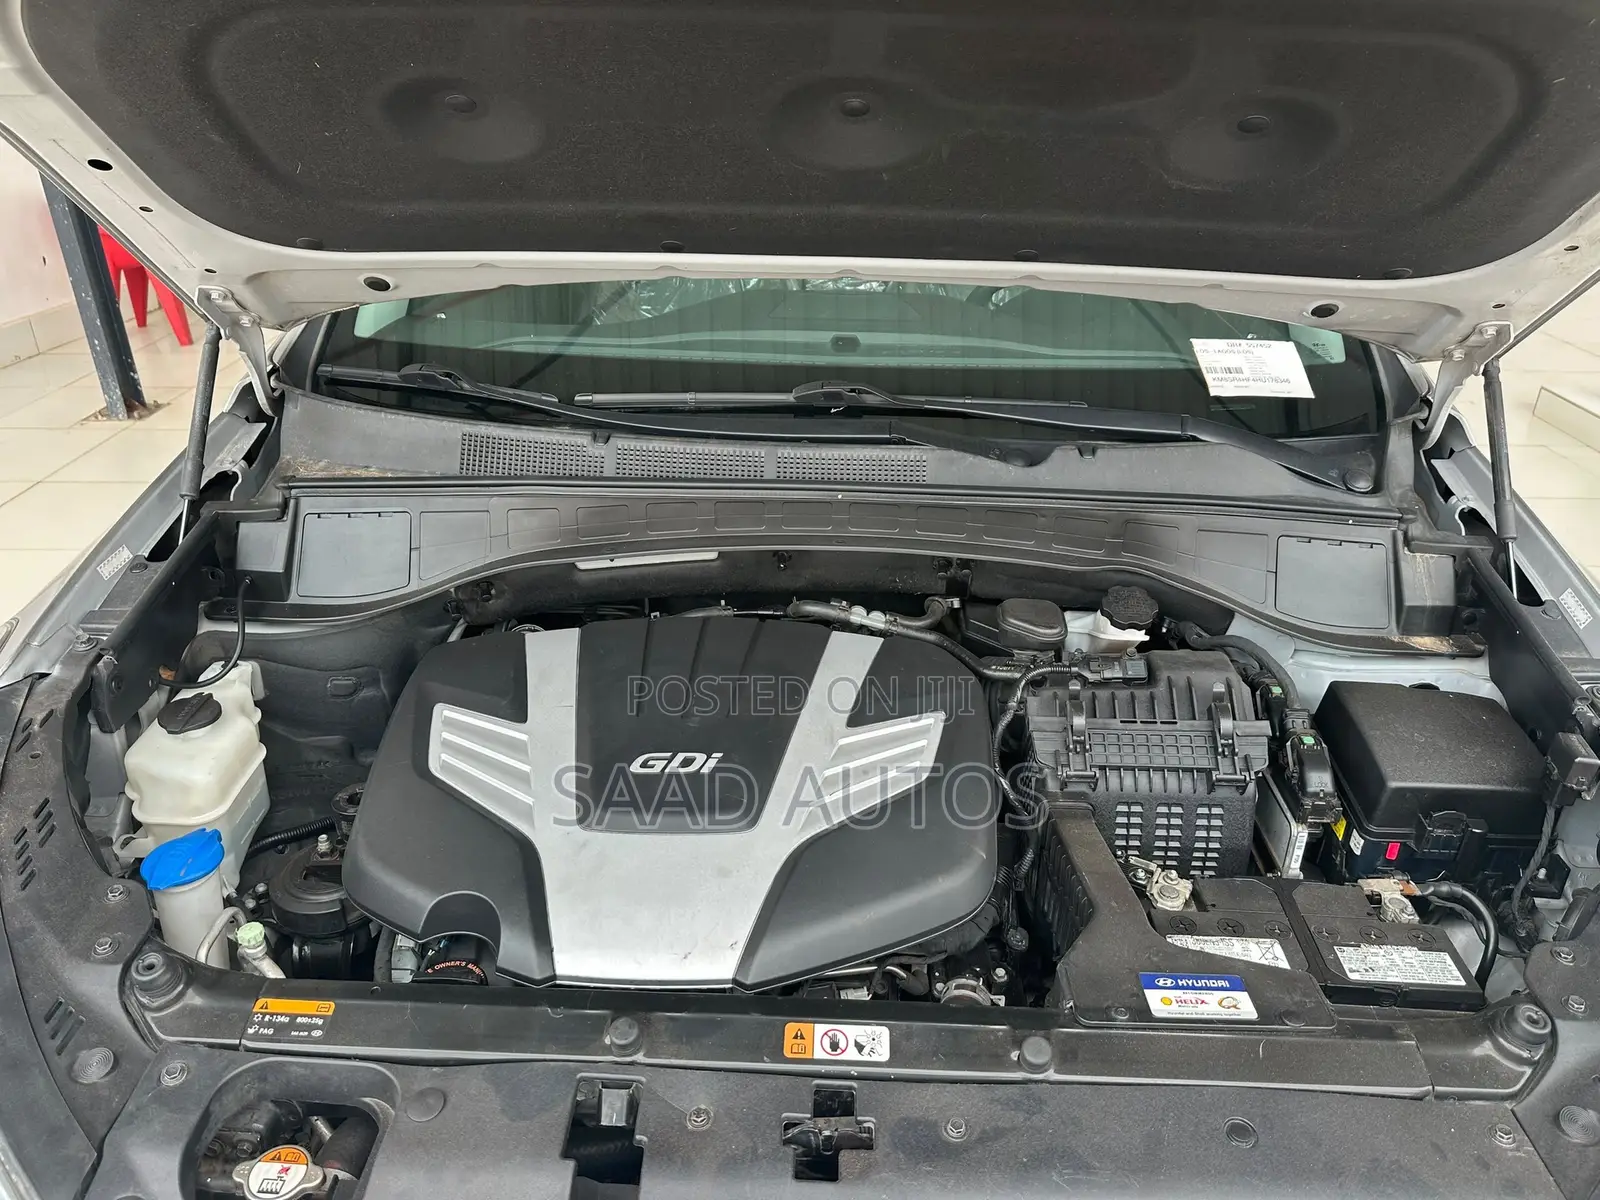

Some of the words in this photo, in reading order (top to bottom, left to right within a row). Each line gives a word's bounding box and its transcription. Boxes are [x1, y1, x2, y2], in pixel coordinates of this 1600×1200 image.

[629, 752, 724, 773] GDi
[434, 961, 466, 970] OWNER'S
[1178, 978, 1230, 988] HYUNDAI
[258, 1027, 274, 1035] PAG
